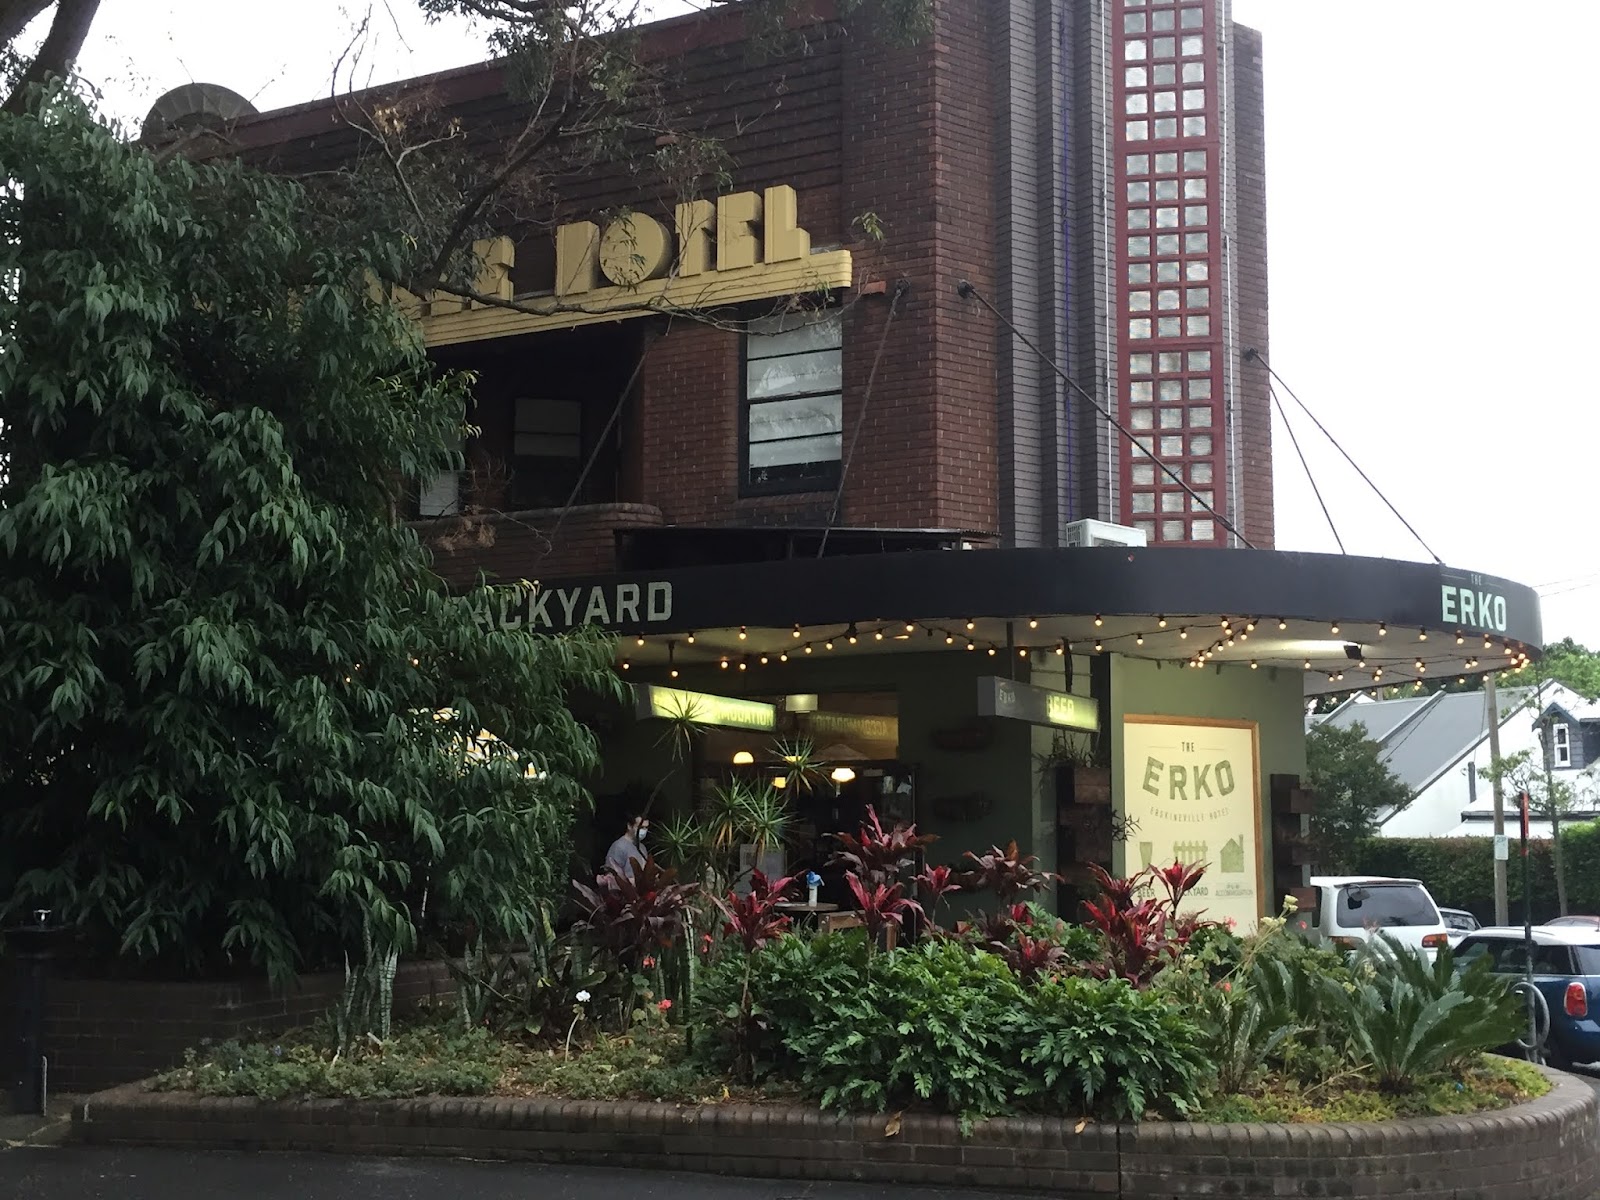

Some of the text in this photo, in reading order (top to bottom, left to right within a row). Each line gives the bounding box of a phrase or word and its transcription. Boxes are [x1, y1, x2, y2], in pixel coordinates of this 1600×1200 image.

[452, 580, 674, 632] ACKYARD
[1441, 584, 1507, 632] ERKO
[1181, 741, 1195, 753] THE
[1142, 756, 1235, 801] ERKO
